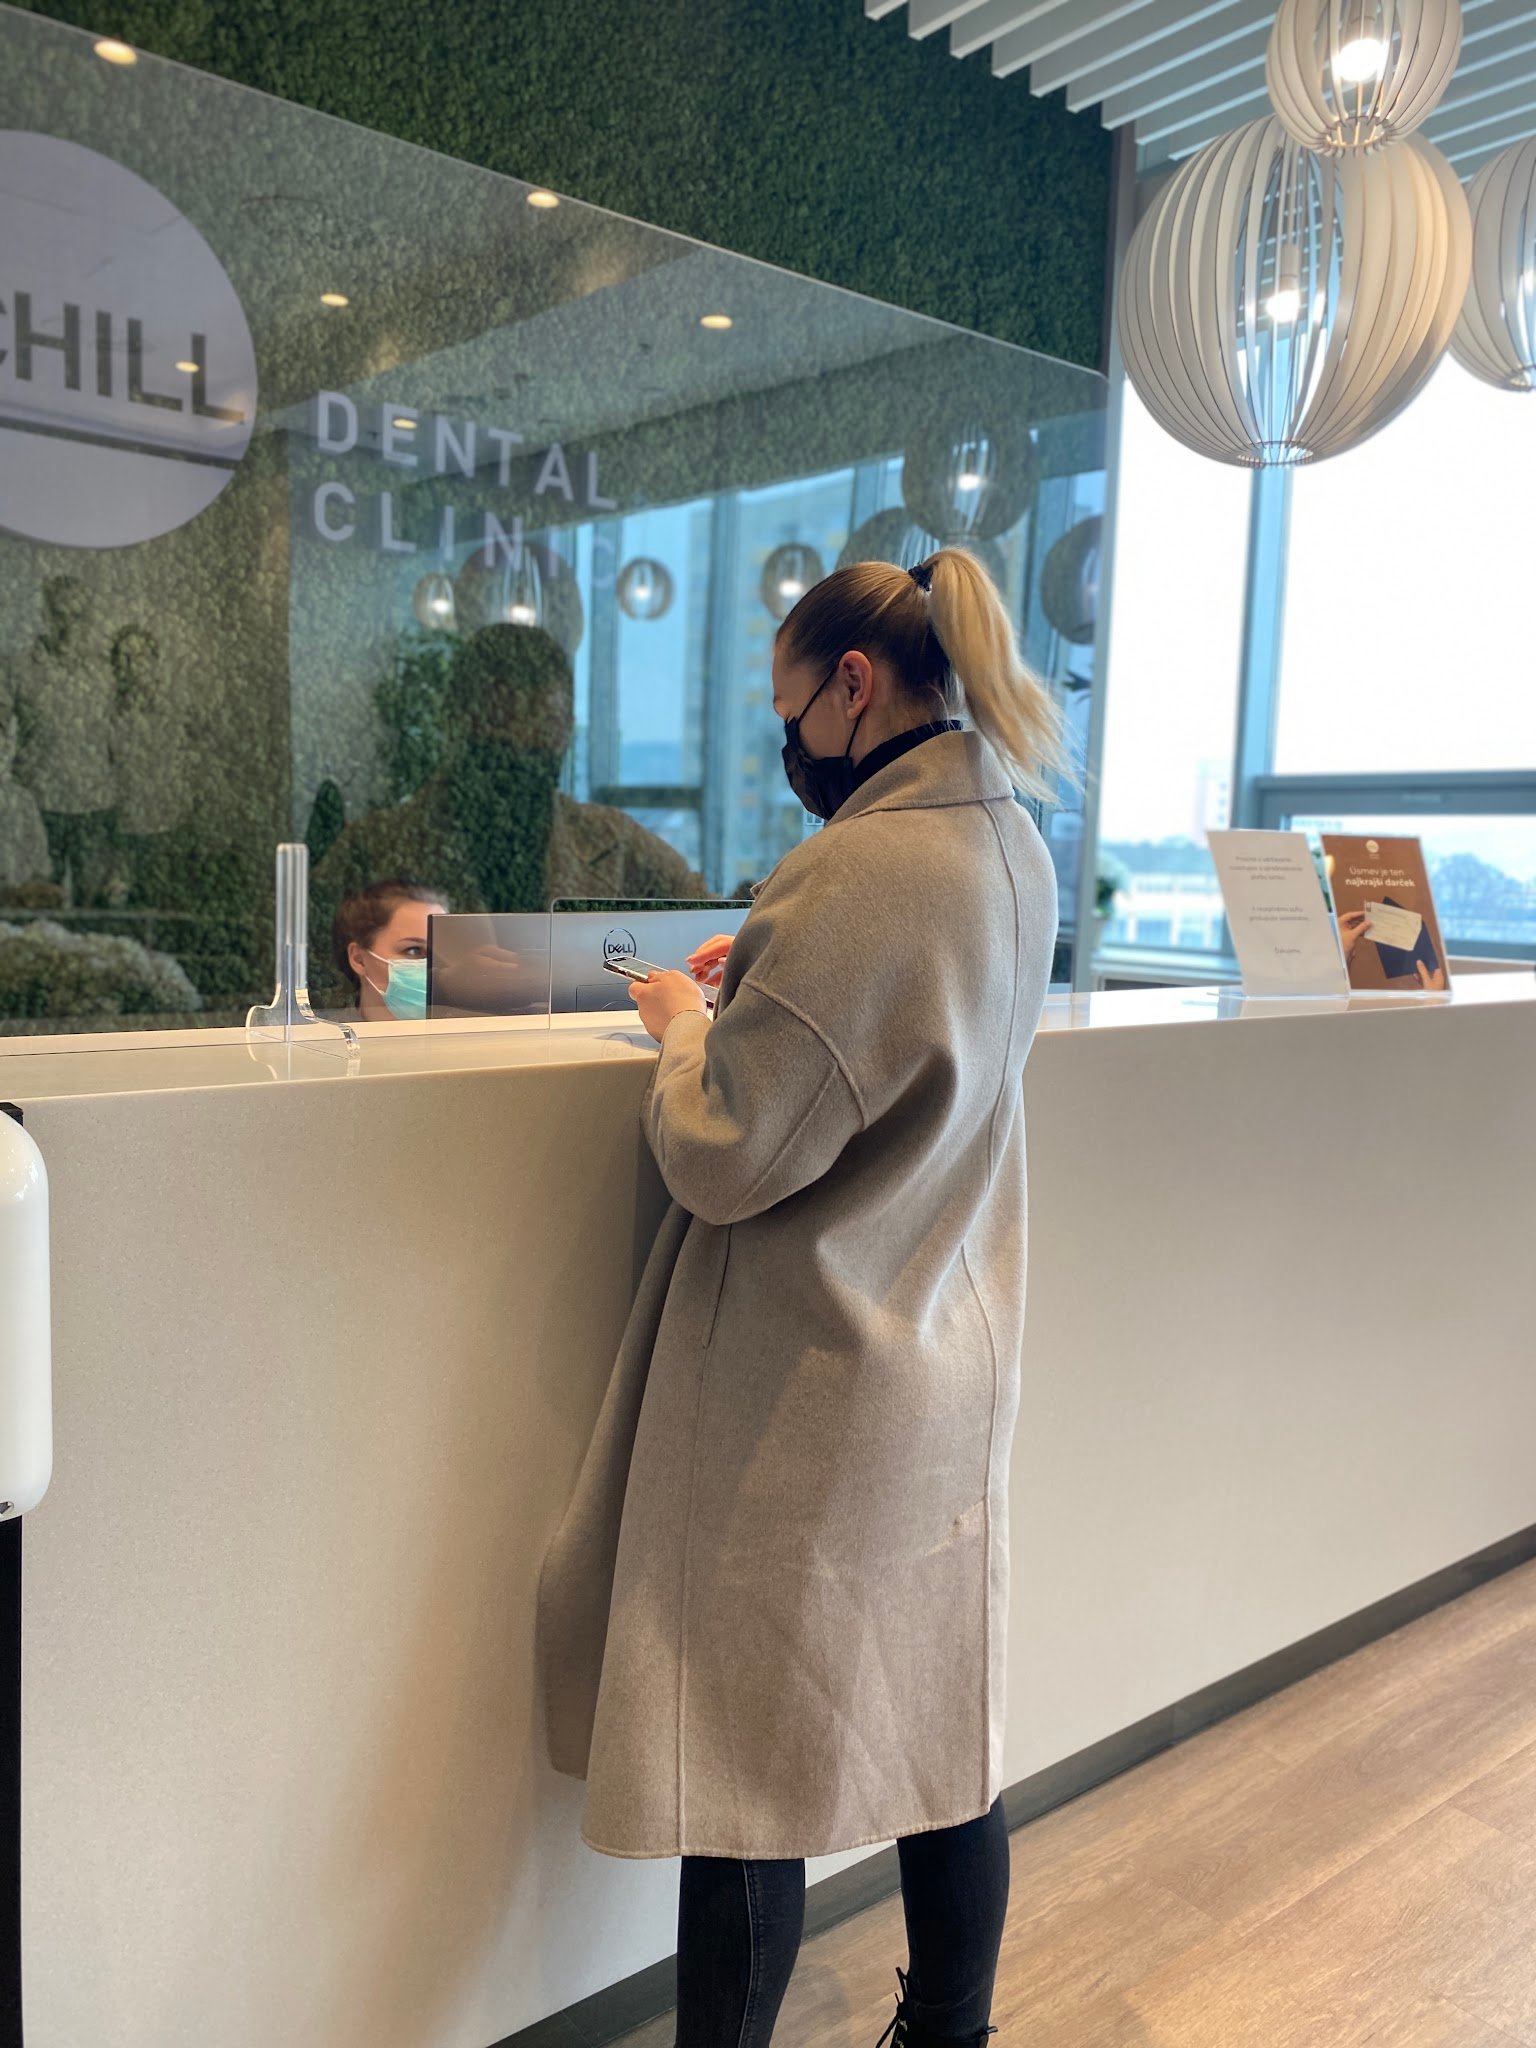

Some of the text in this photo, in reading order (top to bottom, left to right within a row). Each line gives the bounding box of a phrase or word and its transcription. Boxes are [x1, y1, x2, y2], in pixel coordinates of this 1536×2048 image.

[0, 291, 244, 424] HILL
[317, 389, 617, 510] DENTAL
[607, 943, 634, 954] DELL
